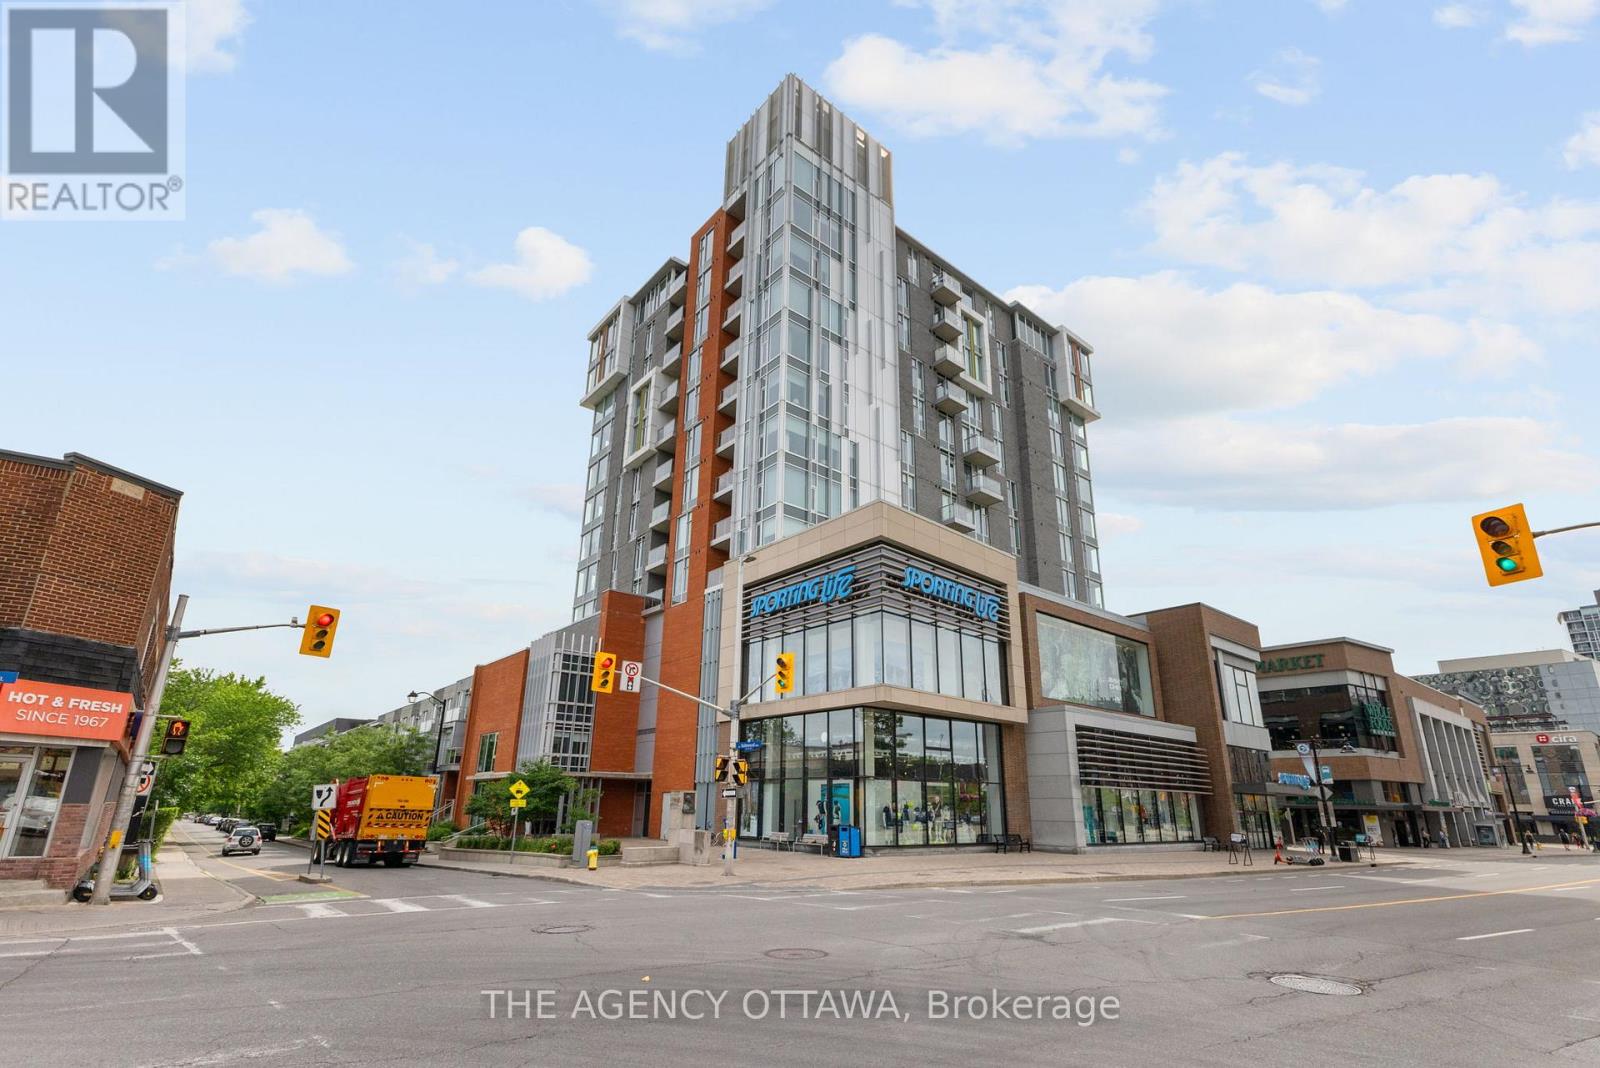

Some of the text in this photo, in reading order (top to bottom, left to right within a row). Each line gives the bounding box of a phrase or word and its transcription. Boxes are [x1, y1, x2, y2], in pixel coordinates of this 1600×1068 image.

[903, 566, 976, 608] SPORTING
[750, 577, 820, 618] SPORTING
[1256, 654, 1324, 673] MARKET
[8, 691, 123, 713] HOT & FRESH
[15, 709, 110, 728] SINCE 1967
[1551, 734, 1577, 743] cira
[385, 812, 425, 821] CAUTION
